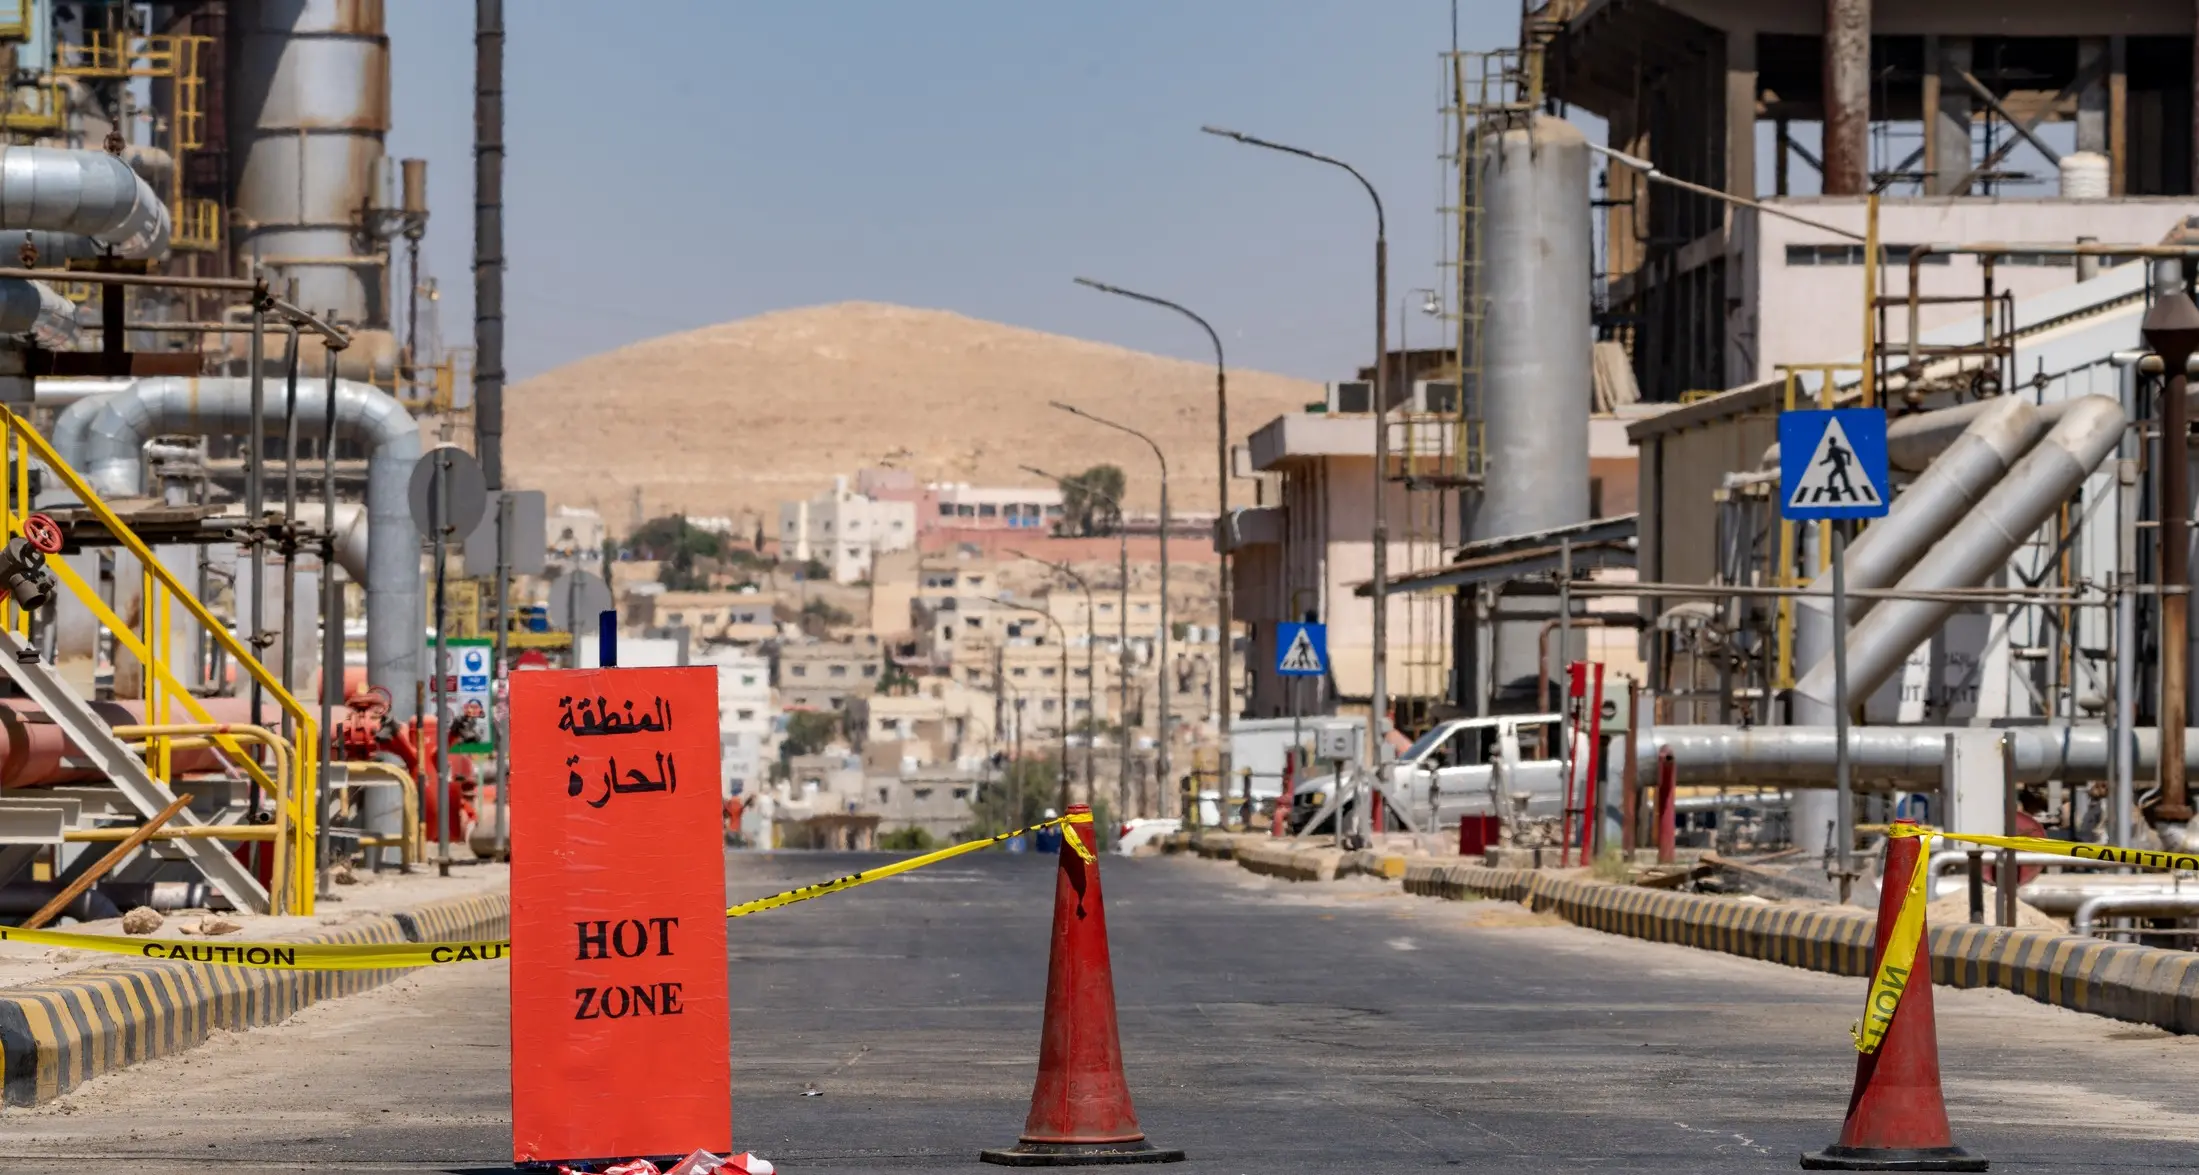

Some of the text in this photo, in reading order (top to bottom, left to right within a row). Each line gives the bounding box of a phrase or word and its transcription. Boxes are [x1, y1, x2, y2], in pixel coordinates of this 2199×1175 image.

[558, 695, 672, 737] المنطقة
[566, 751, 676, 808] الحارة
[142, 943, 295, 966] CAUTION
[431, 943, 511, 963] CAU
[574, 917, 679, 960] HOT
[574, 982, 684, 1020] ZONE
